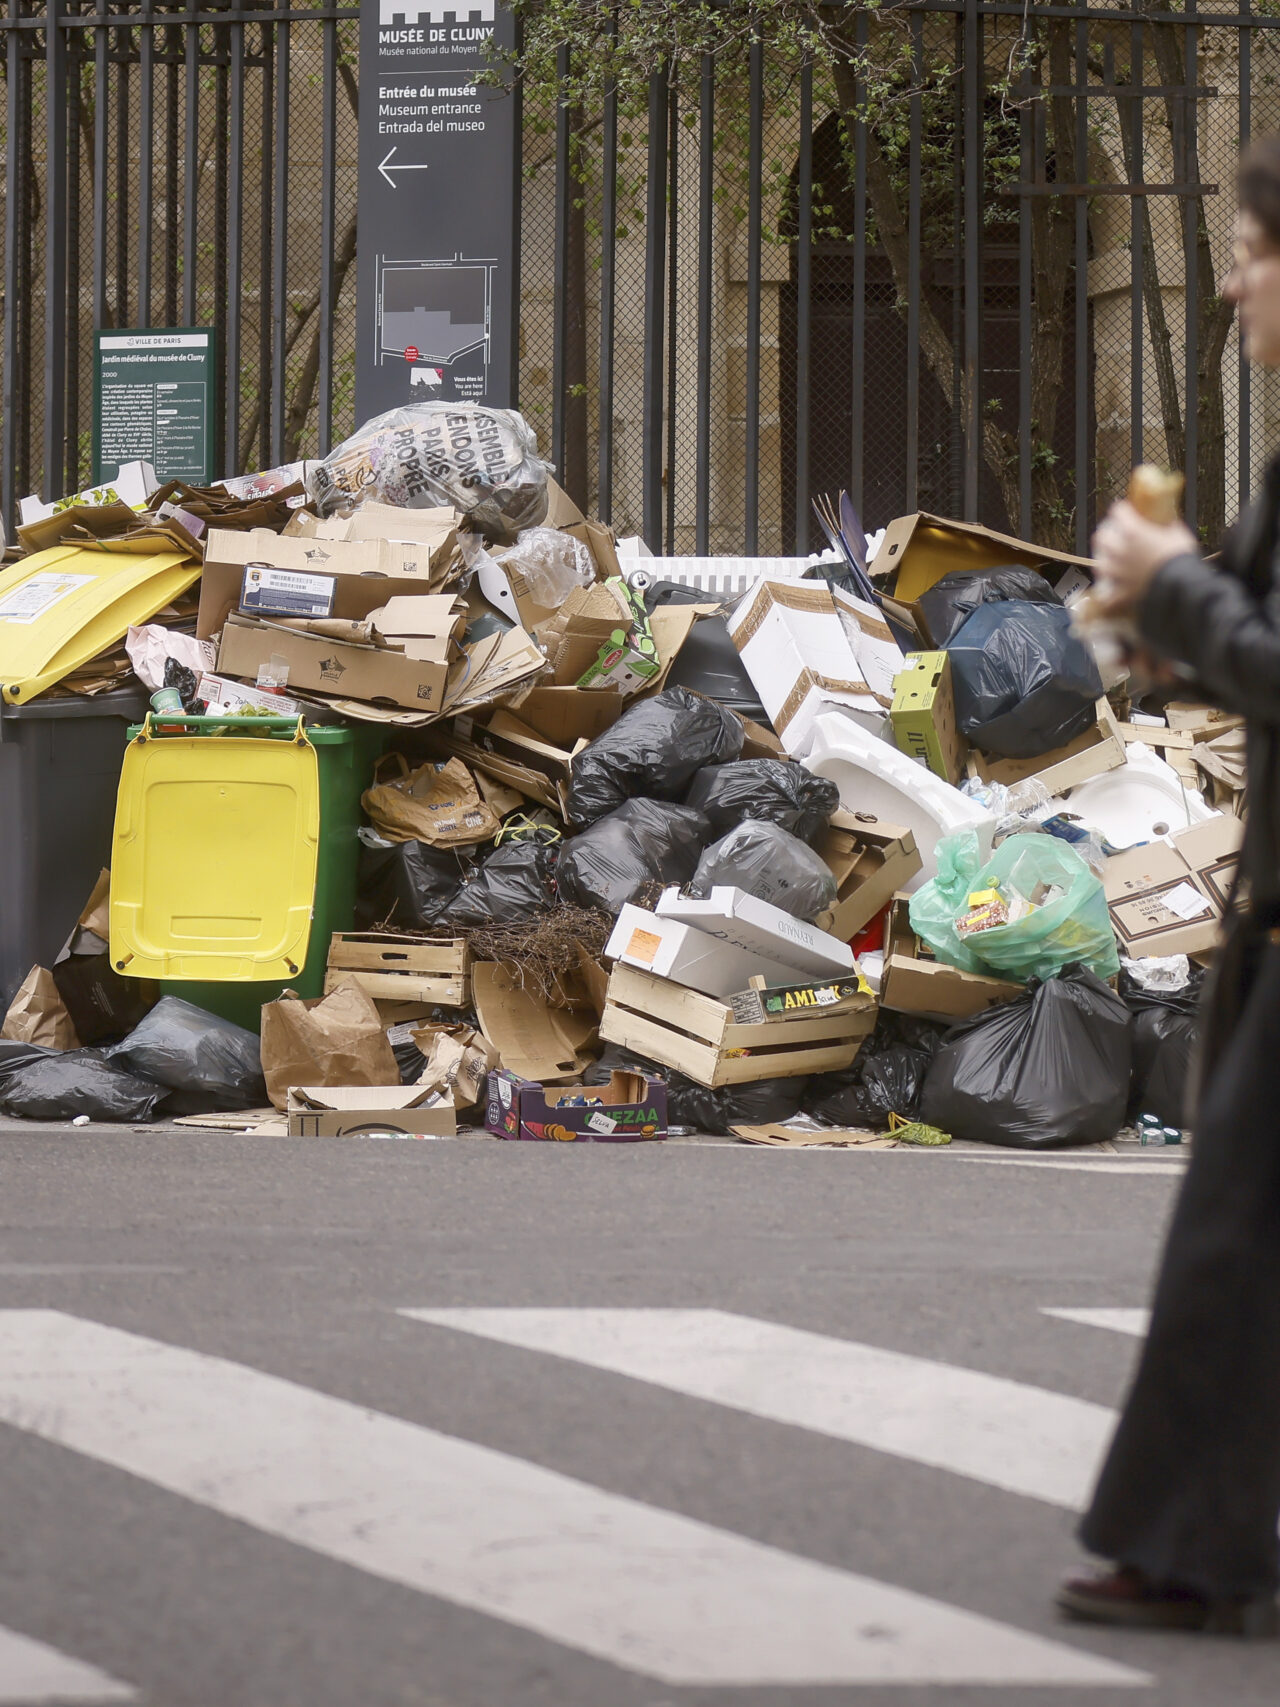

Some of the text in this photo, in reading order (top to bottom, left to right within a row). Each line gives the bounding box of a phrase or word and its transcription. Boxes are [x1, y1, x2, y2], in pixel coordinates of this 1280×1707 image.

[379, 27, 495, 44] MUSÉE DE CLUNY
[379, 45, 478, 56] Musée national du Moyen
[379, 84, 477, 99] Entrée du musée
[378, 103, 482, 116] Museum entrance
[378, 120, 485, 133] Entrada del museo
[102, 355, 120, 364] Jardin
[121, 354, 149, 363] médiéval
[149, 354, 157, 362] du
[157, 354, 177, 362] musée
[187, 353, 205, 363] Cluny
[421, 426, 451, 480] PARIS
[394, 428, 430, 498] PROPRE
[778, 920, 814, 946] REYNAUD
